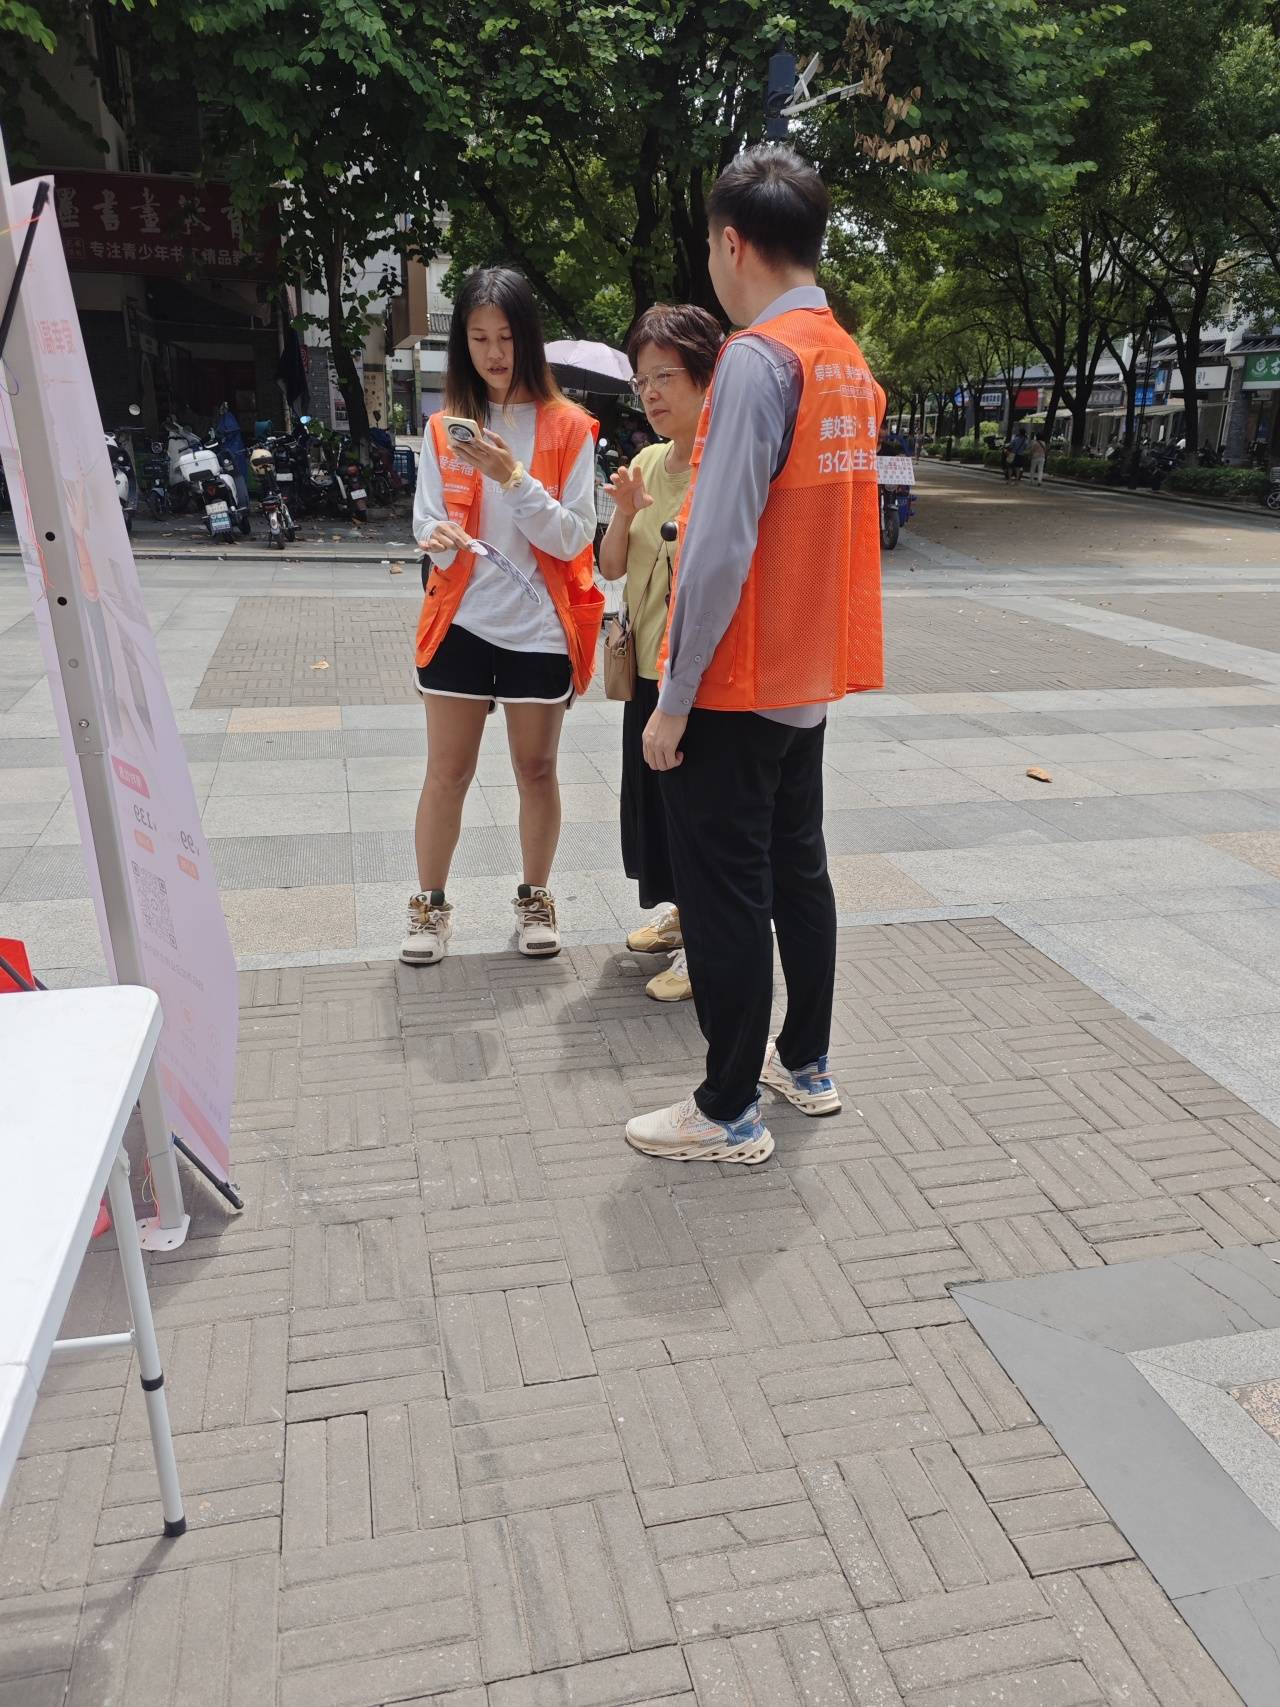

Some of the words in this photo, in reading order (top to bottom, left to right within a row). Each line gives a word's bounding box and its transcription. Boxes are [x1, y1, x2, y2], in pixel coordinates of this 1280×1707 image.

[90, 241, 264, 267] 专注青少年书精品教
